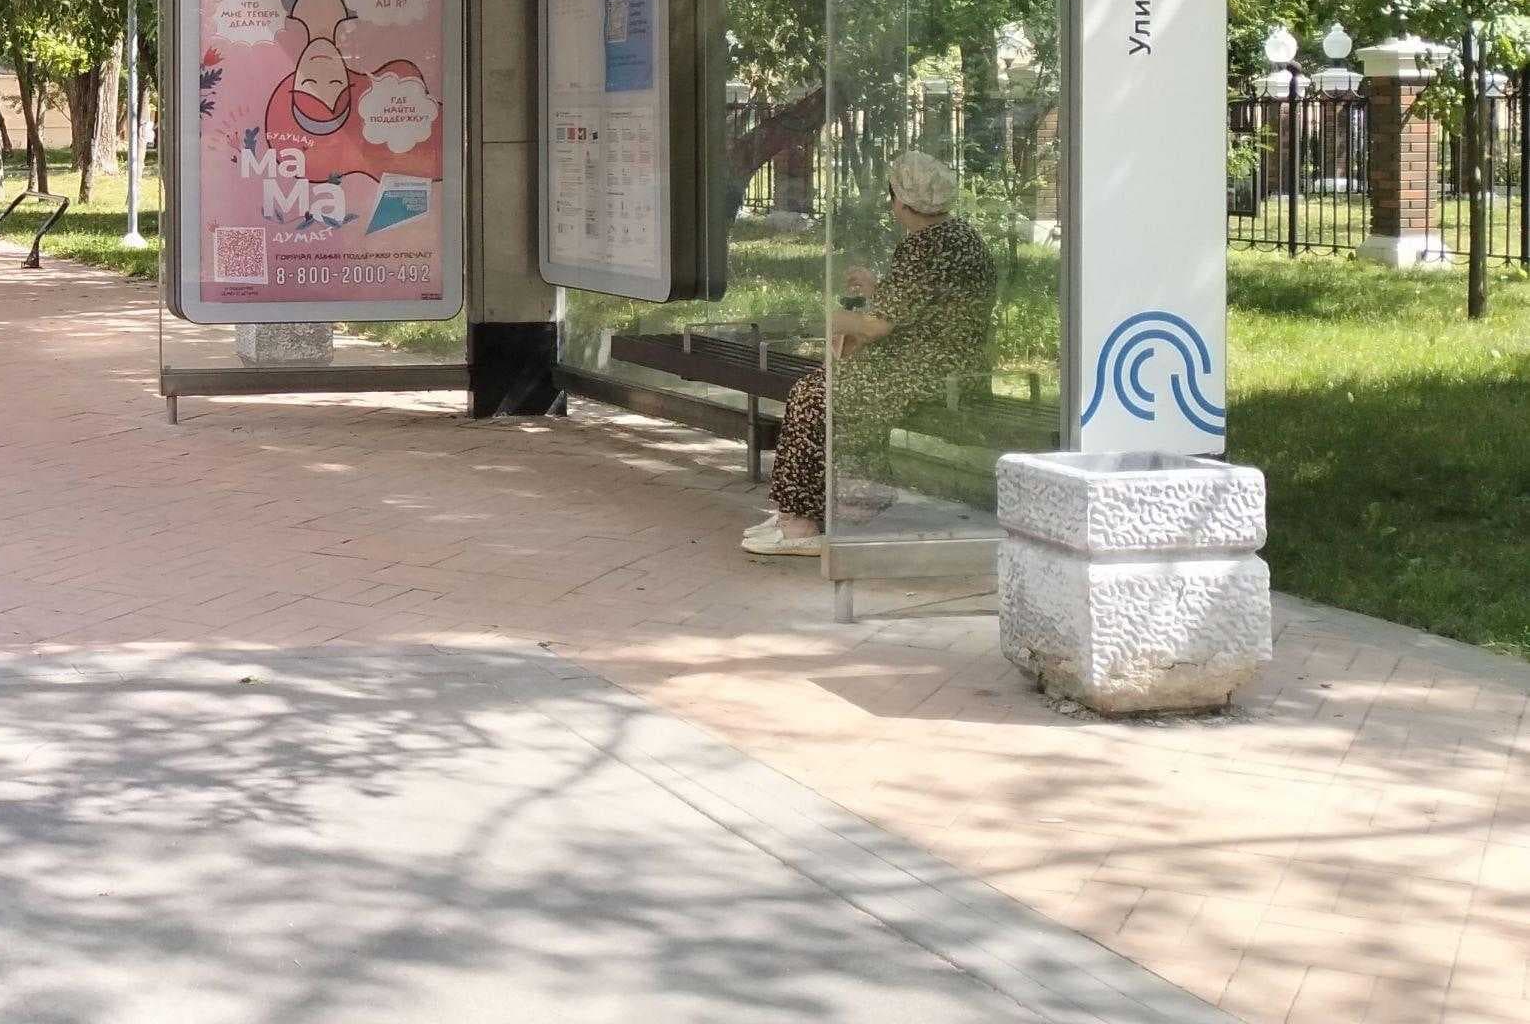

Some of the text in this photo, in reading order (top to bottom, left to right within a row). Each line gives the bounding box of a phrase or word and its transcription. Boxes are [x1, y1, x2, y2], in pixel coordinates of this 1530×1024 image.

[240, 1, 260, 9] ЧТО
[272, 227, 334, 243] ДУМАЕТ
[275, 264, 431, 285] 8-800-2000-492
